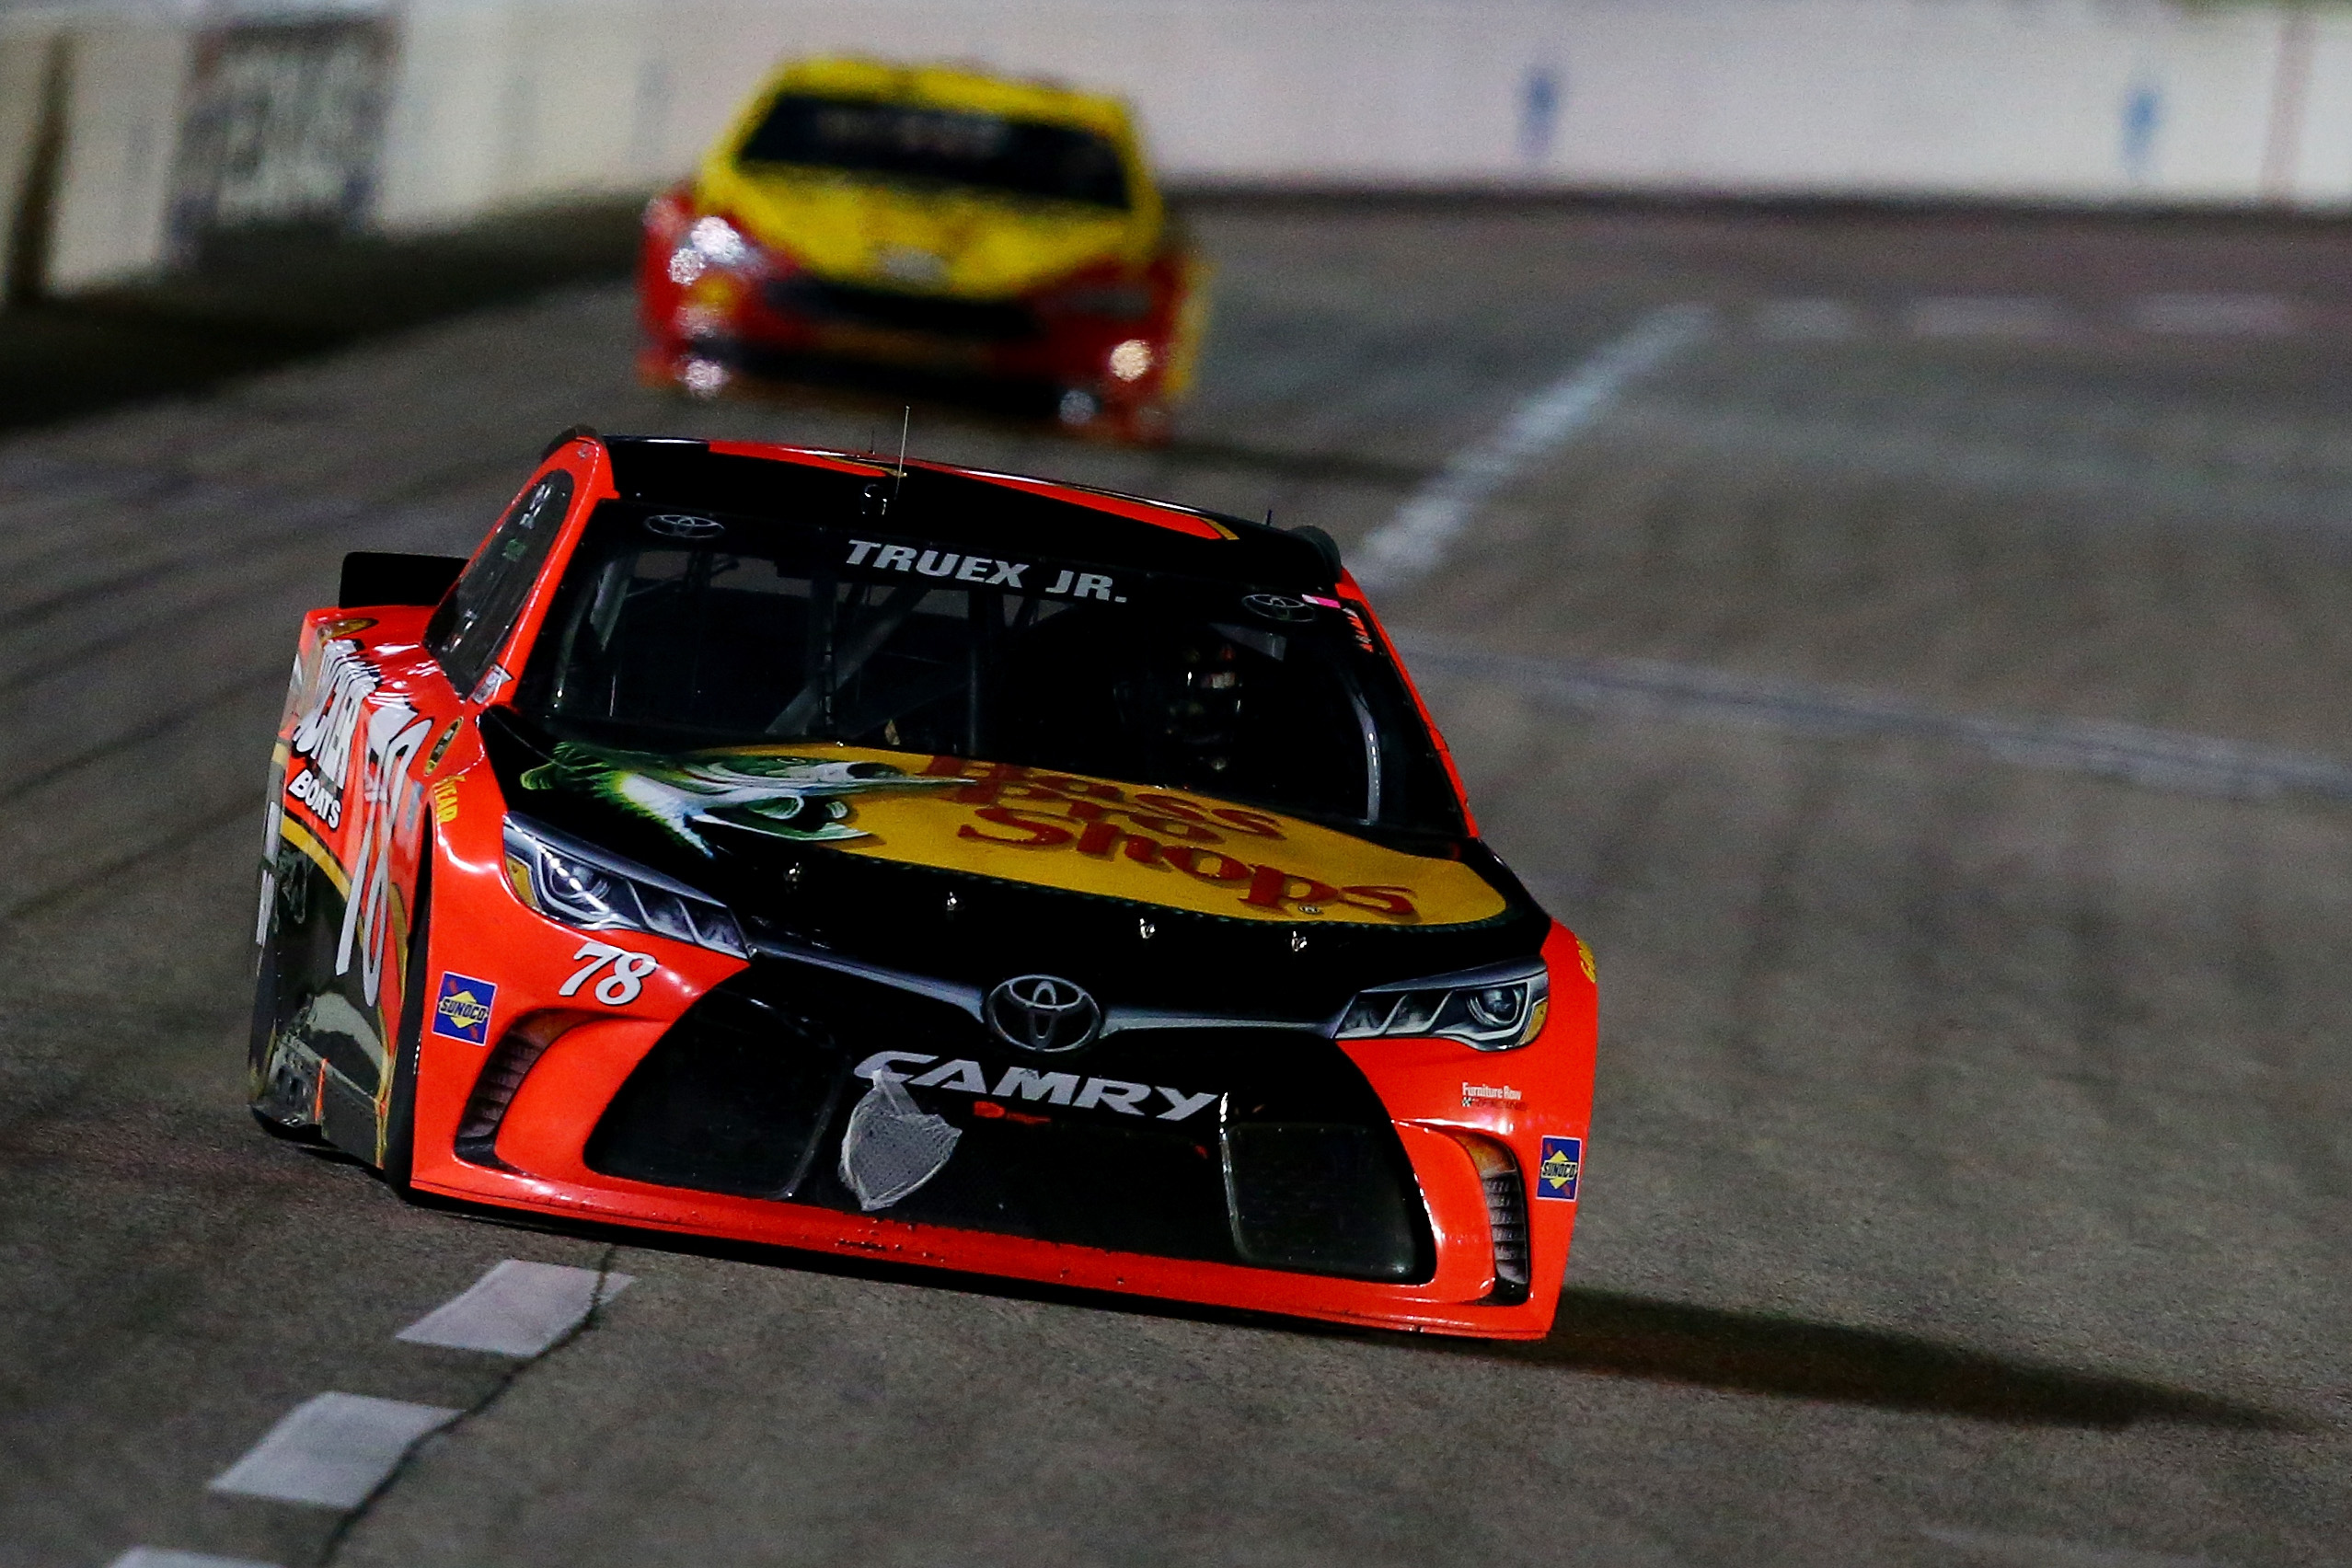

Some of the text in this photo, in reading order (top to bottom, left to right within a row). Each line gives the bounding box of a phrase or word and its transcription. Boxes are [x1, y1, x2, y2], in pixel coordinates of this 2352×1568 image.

[846, 539, 1127, 604] TRUEX JR.
[288, 769, 342, 829] BOATS
[915, 755, 1285, 839] Bass
[958, 806, 1416, 915] Shops
[559, 943, 657, 1005] 78
[440, 997, 488, 1021] SUNOCO
[854, 1051, 1218, 1122] CAMRY
[1461, 1082, 1503, 1099] Furniture
[1542, 1161, 1576, 1178] SUNOCO
